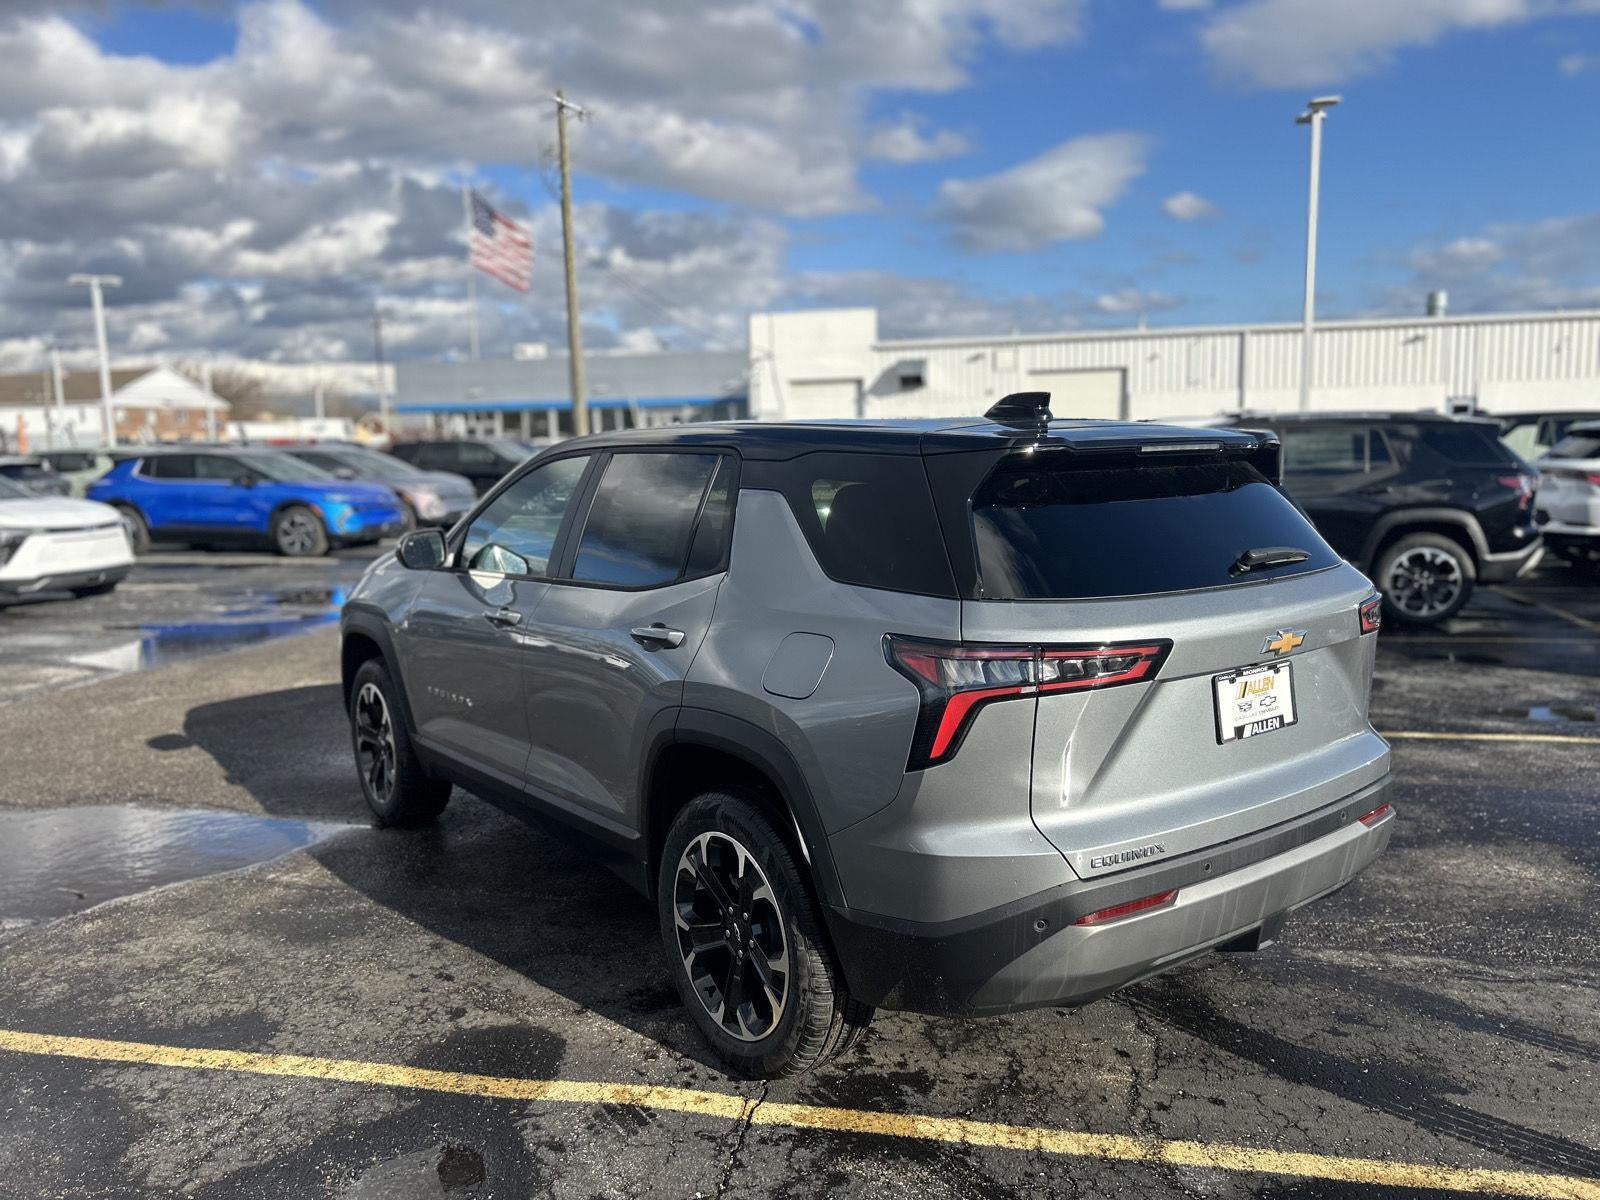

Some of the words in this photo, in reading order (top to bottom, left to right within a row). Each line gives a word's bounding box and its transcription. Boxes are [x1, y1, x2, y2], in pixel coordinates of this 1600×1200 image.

[1243, 666, 1268, 676] MONROE
[1247, 676, 1275, 694] ALLEN
[1251, 717, 1280, 735] ALLEN
[1090, 841, 1165, 868] EQUINOX
